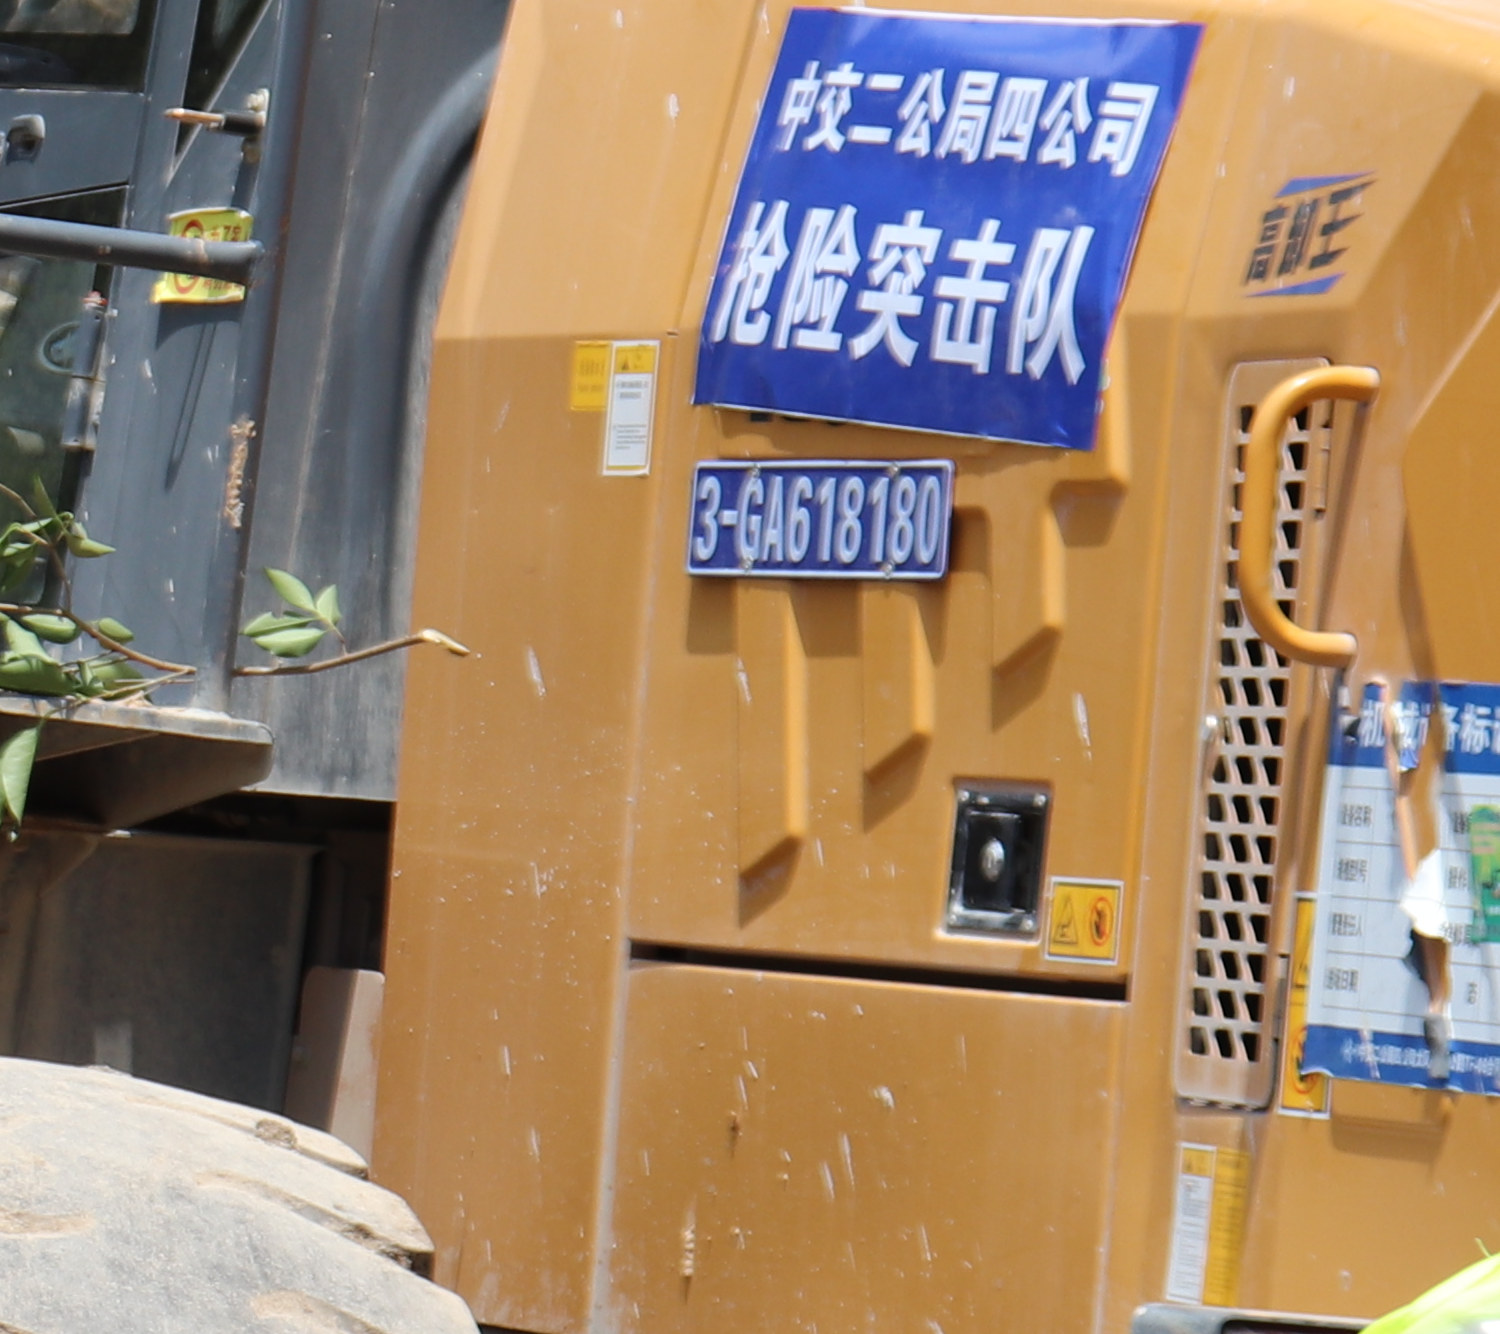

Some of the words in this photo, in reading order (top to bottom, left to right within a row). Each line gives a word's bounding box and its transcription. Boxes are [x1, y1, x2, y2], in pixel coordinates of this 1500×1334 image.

[777, 59, 1160, 177] 中交二公局四公司
[712, 199, 1096, 386] 抢险突击队
[693, 475, 941, 564] 3-GA618180
